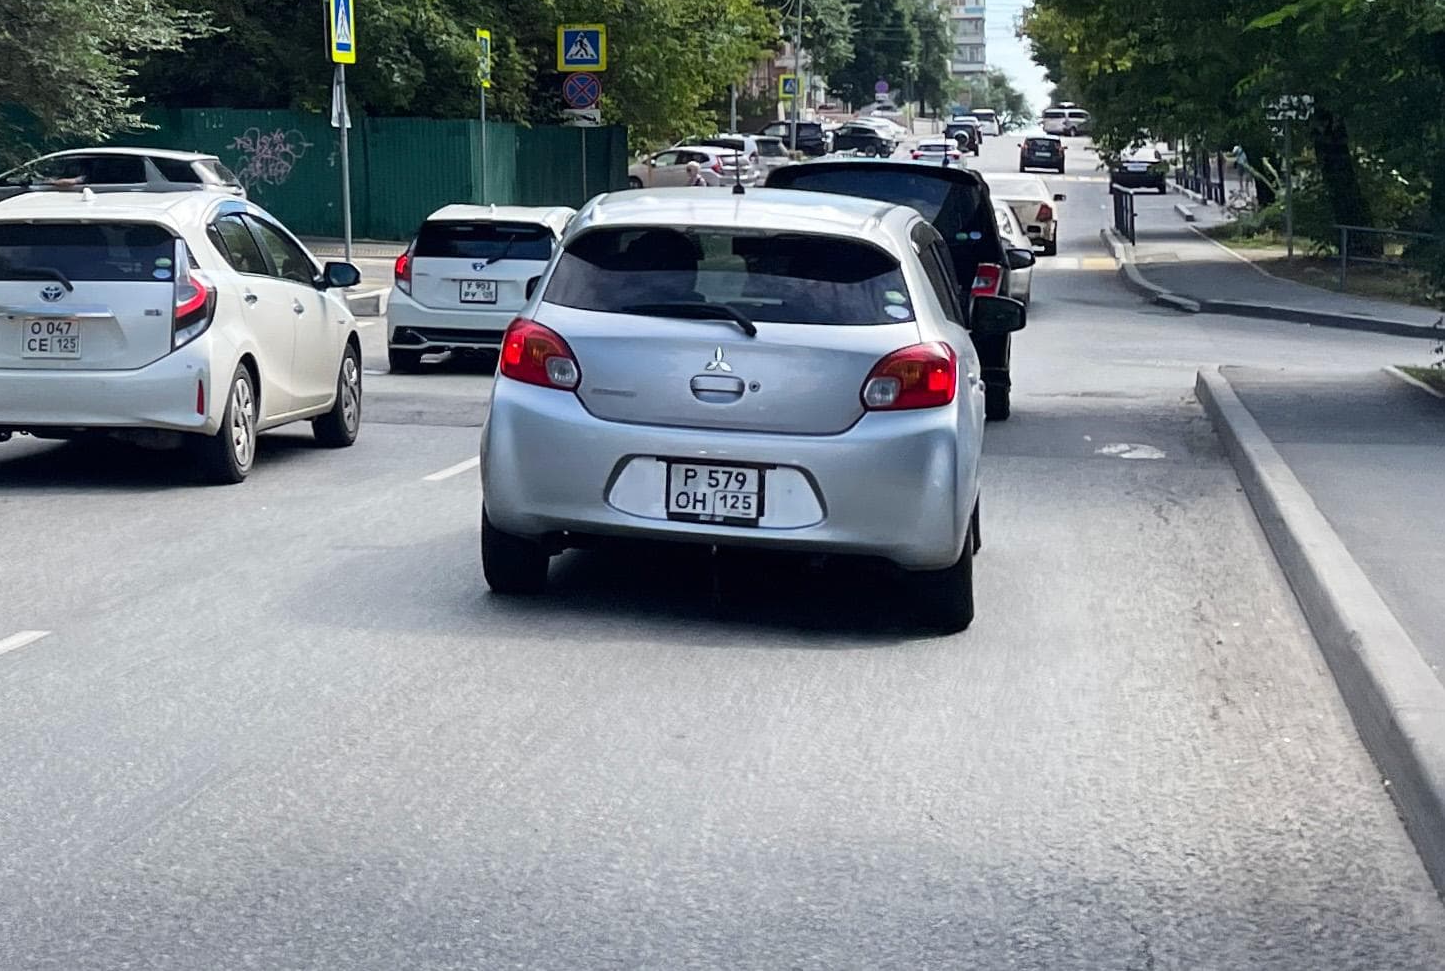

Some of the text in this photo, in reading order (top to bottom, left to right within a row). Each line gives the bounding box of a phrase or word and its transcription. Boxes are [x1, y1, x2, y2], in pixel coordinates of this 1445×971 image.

[46, 321, 72, 335] 047
[56, 337, 77, 350] 125
[707, 469, 748, 490] 579
[719, 494, 752, 511] 125
